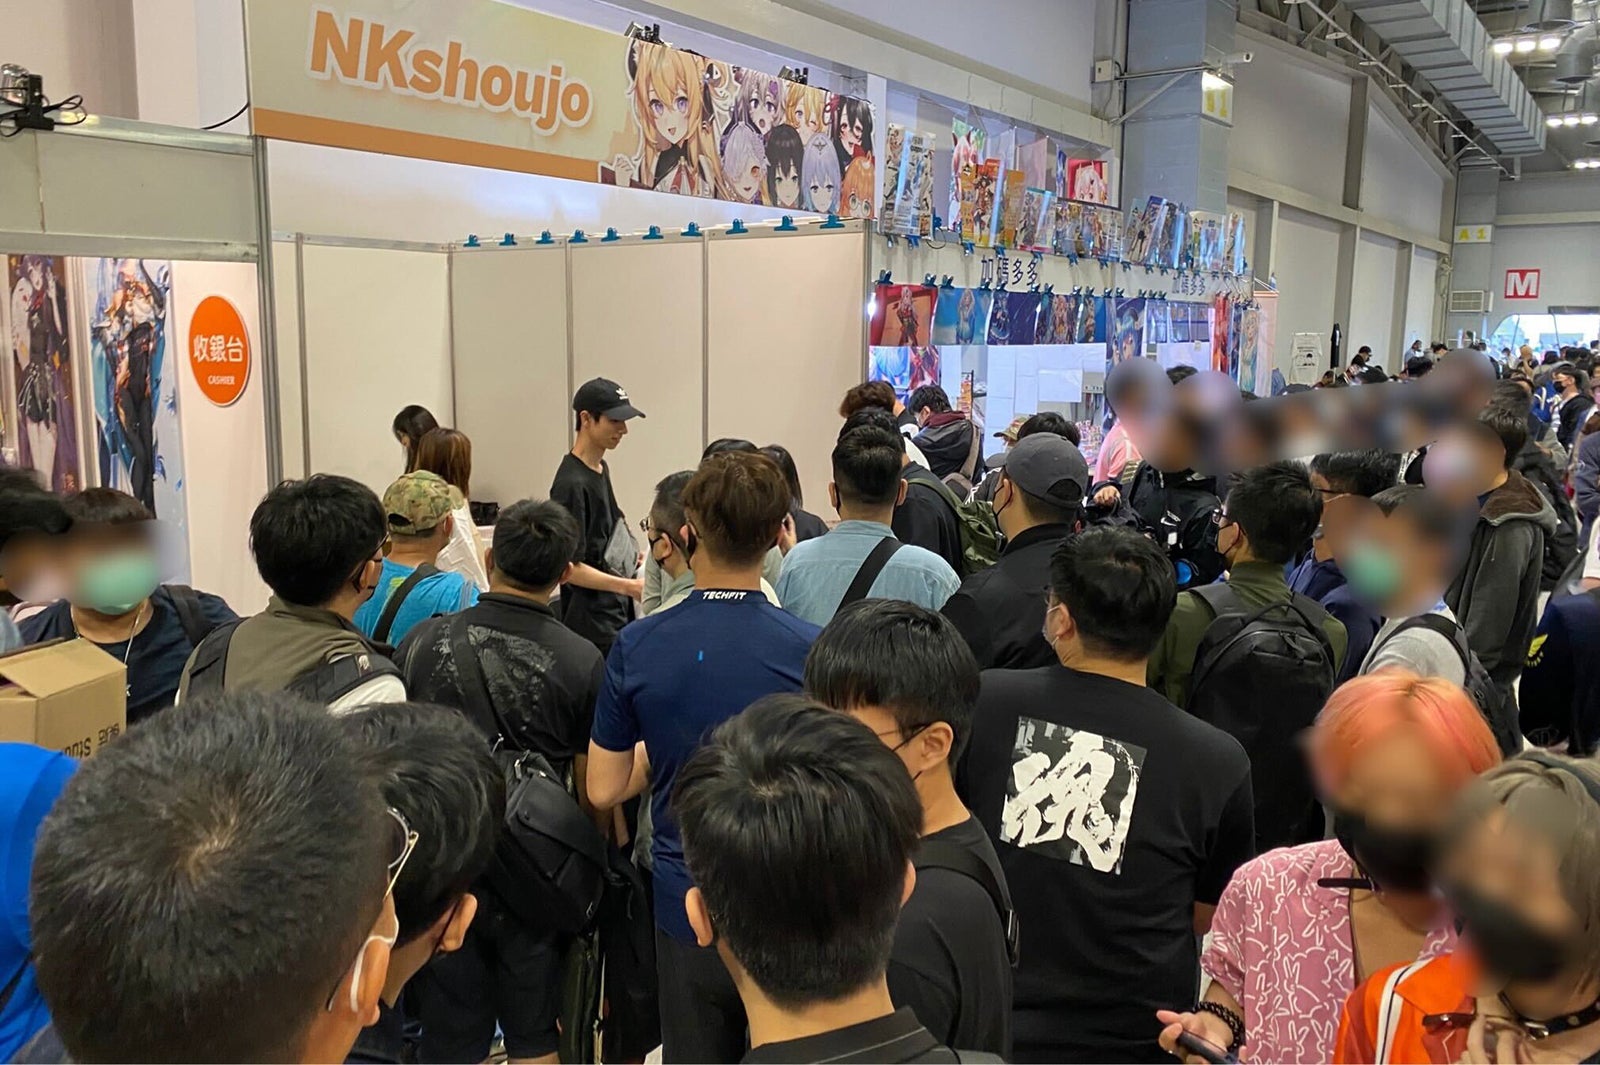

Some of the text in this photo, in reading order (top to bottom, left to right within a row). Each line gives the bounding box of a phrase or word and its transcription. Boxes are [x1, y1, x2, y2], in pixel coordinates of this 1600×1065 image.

[310, 10, 591, 130] NKshoujo
[1506, 272, 1539, 296] M
[193, 334, 244, 363] 收銀台
[207, 375, 235, 385] CASHIER
[702, 591, 747, 600] TECHFIT
